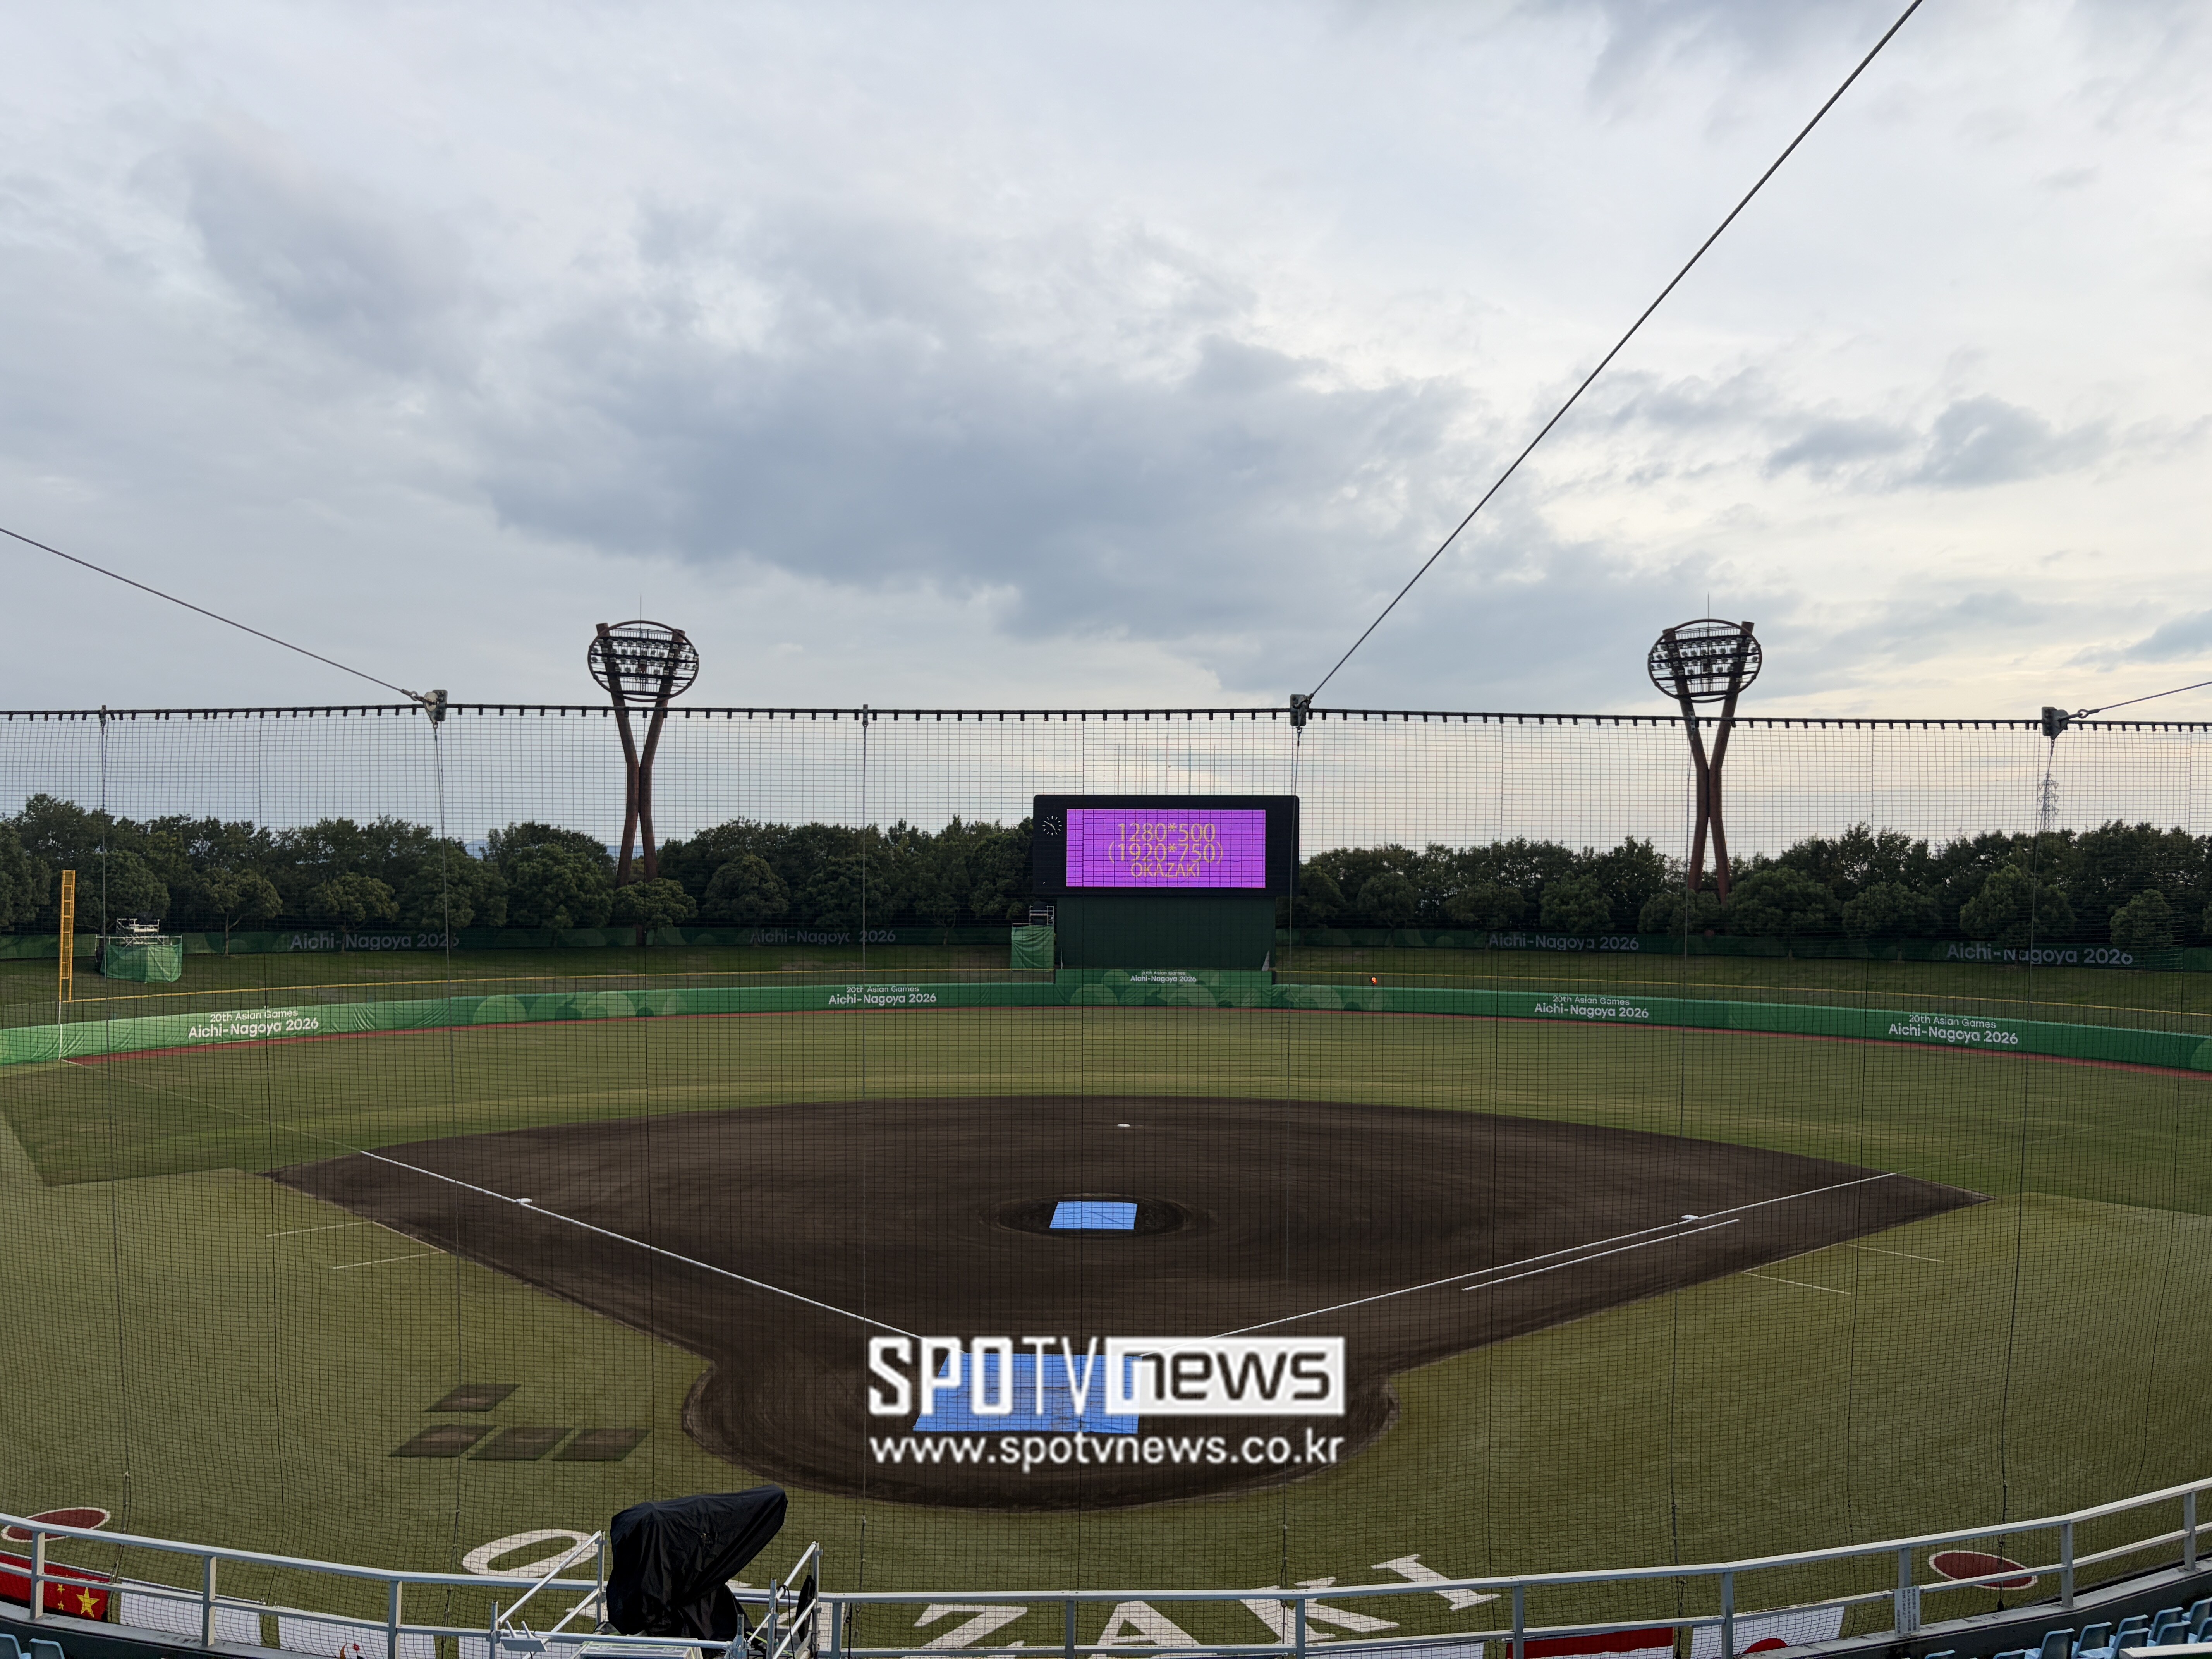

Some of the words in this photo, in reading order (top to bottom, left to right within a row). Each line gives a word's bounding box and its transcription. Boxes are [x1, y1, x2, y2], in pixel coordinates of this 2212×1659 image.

[1131, 862, 1200, 877] OKAZAKI
[289, 933, 412, 951] Aichi-Nagoya
[859, 929, 896, 942] 2026
[1489, 933, 1595, 951] Aichi-Nagoya
[1599, 936, 1639, 950] 2026
[1946, 943, 2078, 965] Aichi-Nagoya
[2083, 948, 2133, 965] 2026
[1130, 975, 1178, 984] Aichi-Nagoya
[828, 994, 906, 1006] Aichi-Nagoya
[908, 993, 937, 1003] 2026
[1574, 996, 1597, 1004] Asian
[1600, 997, 1630, 1006] Games
[210, 1012, 233, 1023] 20th
[235, 1010, 262, 1021] Asian
[264, 1009, 298, 1019] Games
[1534, 1003, 1616, 1018] Aichi-Nagoya
[1619, 1007, 1649, 1018] 2026
[188, 1022, 282, 1039] Aichi-Nagoya
[286, 1017, 319, 1031] 2026
[1909, 1015, 1930, 1024] 20th
[1933, 1016, 1959, 1026] Asian
[1962, 1018, 1997, 1029] Games
[1889, 1022, 1980, 1044] Aichi-Nagoya
[1984, 1030, 2018, 1045] 2026
